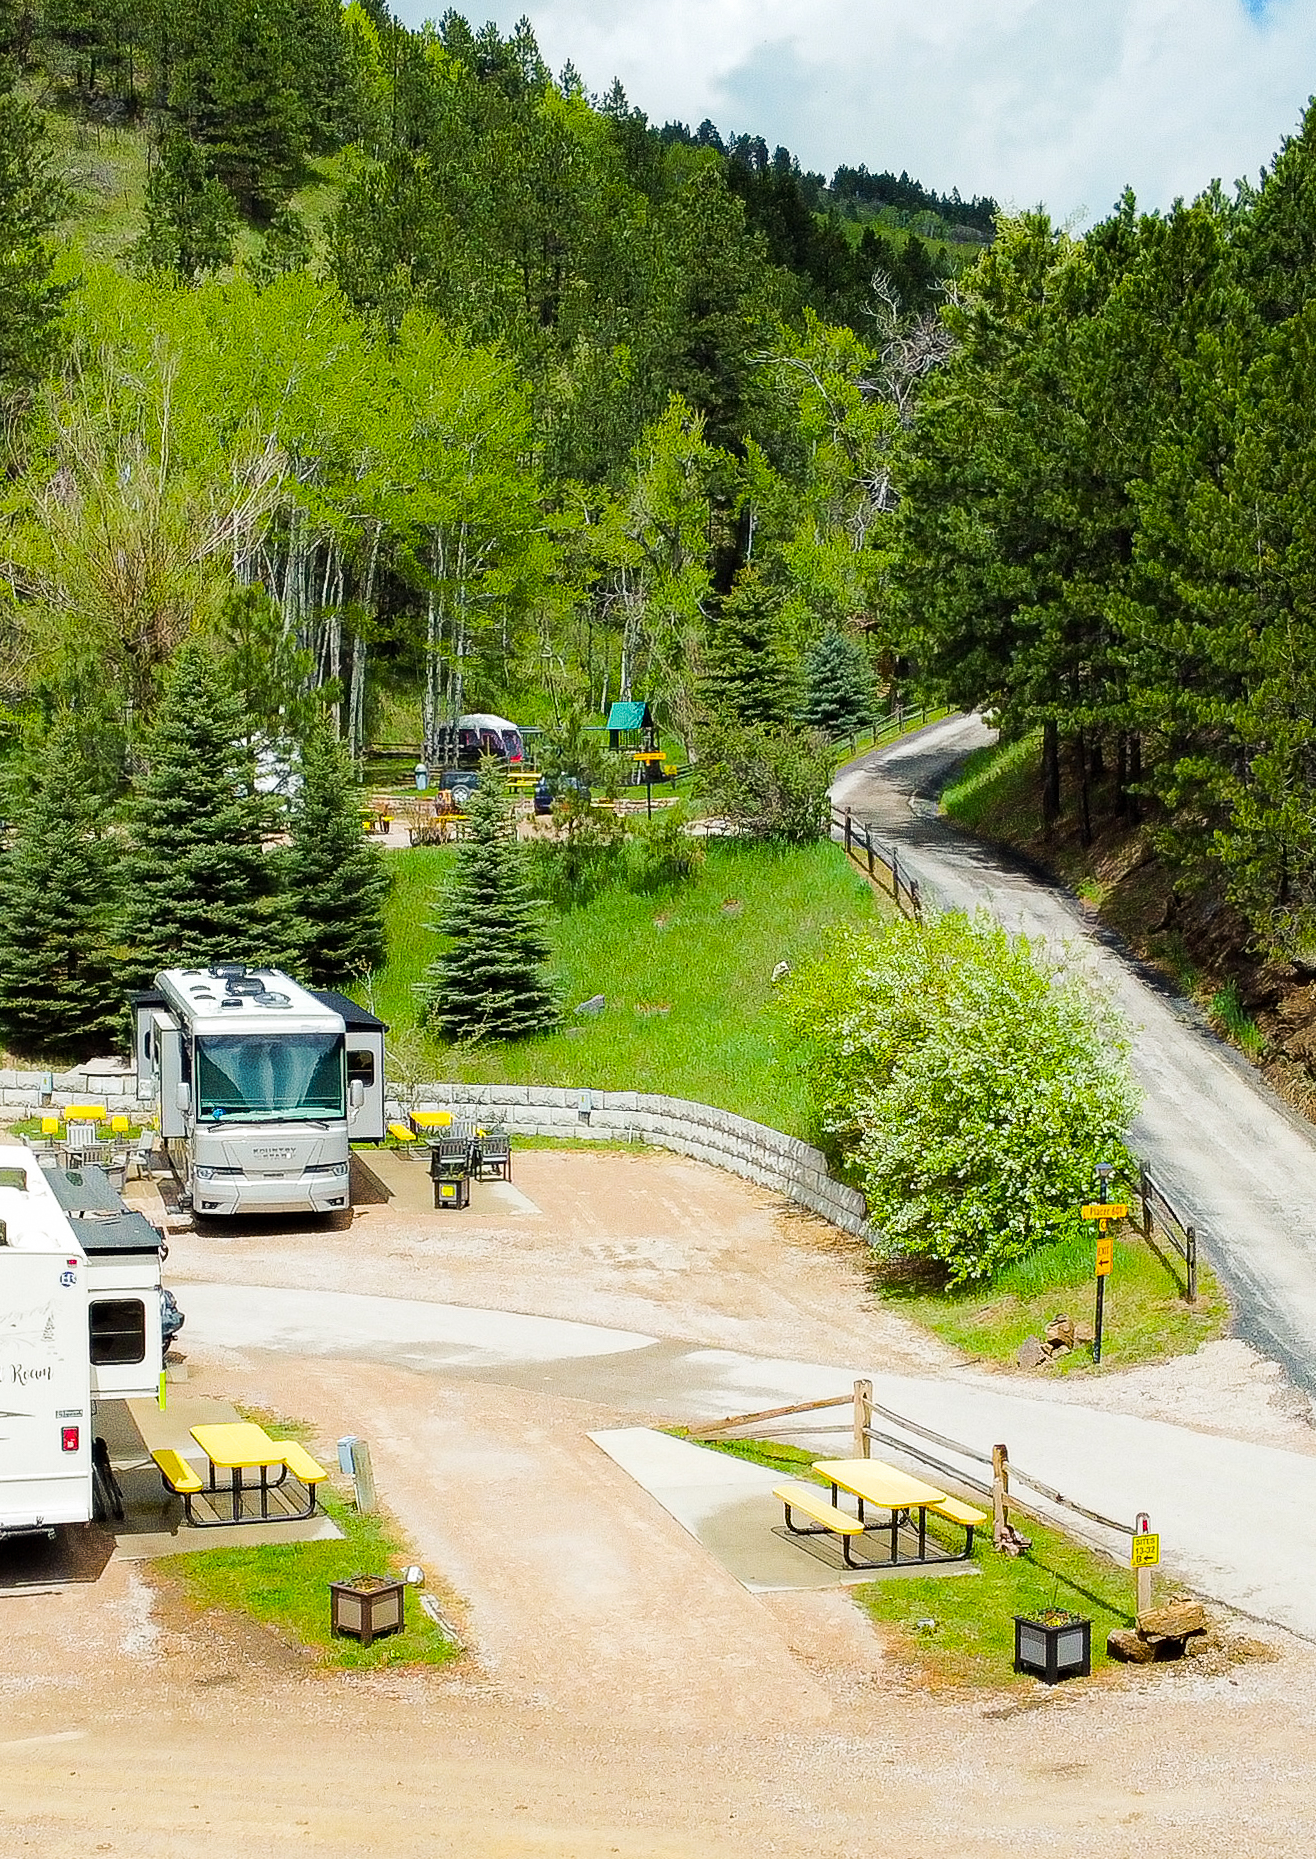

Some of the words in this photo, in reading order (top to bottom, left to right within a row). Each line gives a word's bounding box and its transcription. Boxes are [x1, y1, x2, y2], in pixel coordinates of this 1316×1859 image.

[1098, 1246, 1109, 1256] EXIT
[10, 1364, 53, 1386] Roam
[1136, 1538, 1155, 1546] SITES
[1136, 1546, 1155, 1554] 13-32
